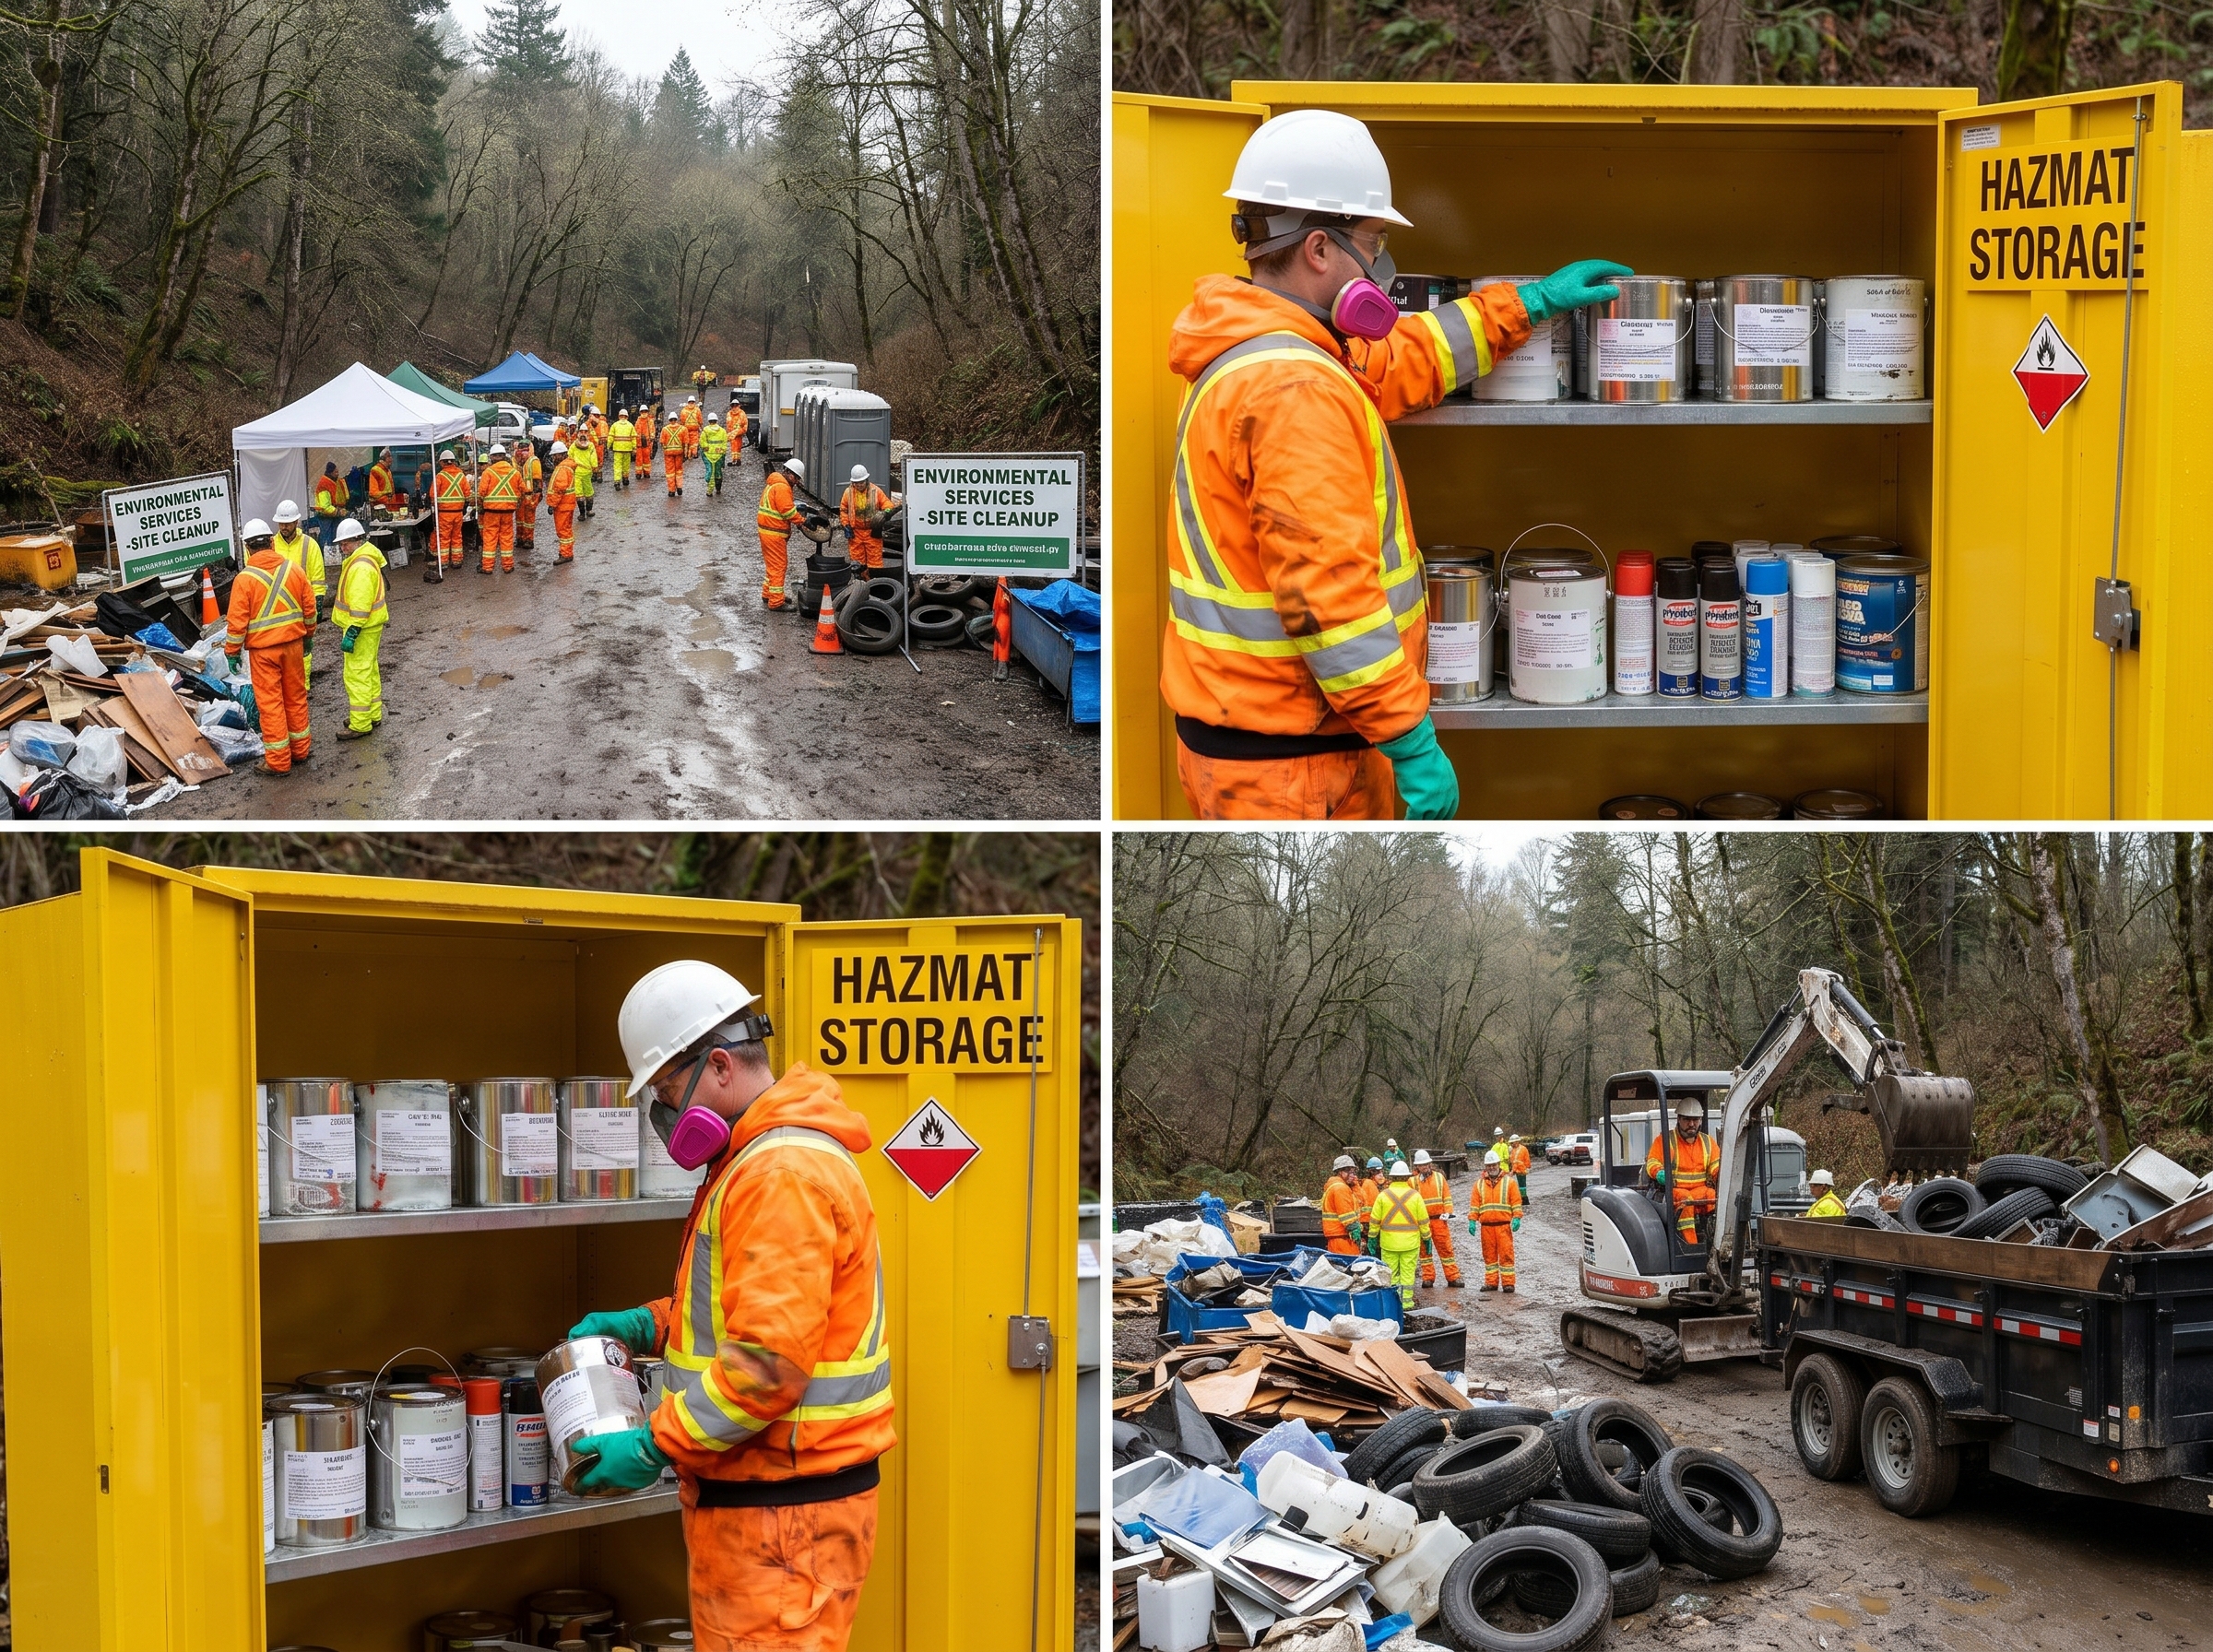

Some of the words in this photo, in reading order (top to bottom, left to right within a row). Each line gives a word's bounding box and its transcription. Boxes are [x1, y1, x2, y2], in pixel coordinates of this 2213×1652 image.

[1981, 147, 2135, 211] HAZMAT
[1970, 221, 2145, 280] STORAGE
[914, 468, 1071, 485] ENVIRONMENTAL
[114, 485, 224, 516] ENVIRONMENTAL
[944, 490, 1035, 505] SERVICES
[139, 506, 202, 530] SERVICES
[973, 511, 1059, 527] CLEANUP
[162, 520, 219, 544] CLEANUP
[833, 953, 1032, 1004] HAZMAT
[820, 1015, 1044, 1066] STORAGE
